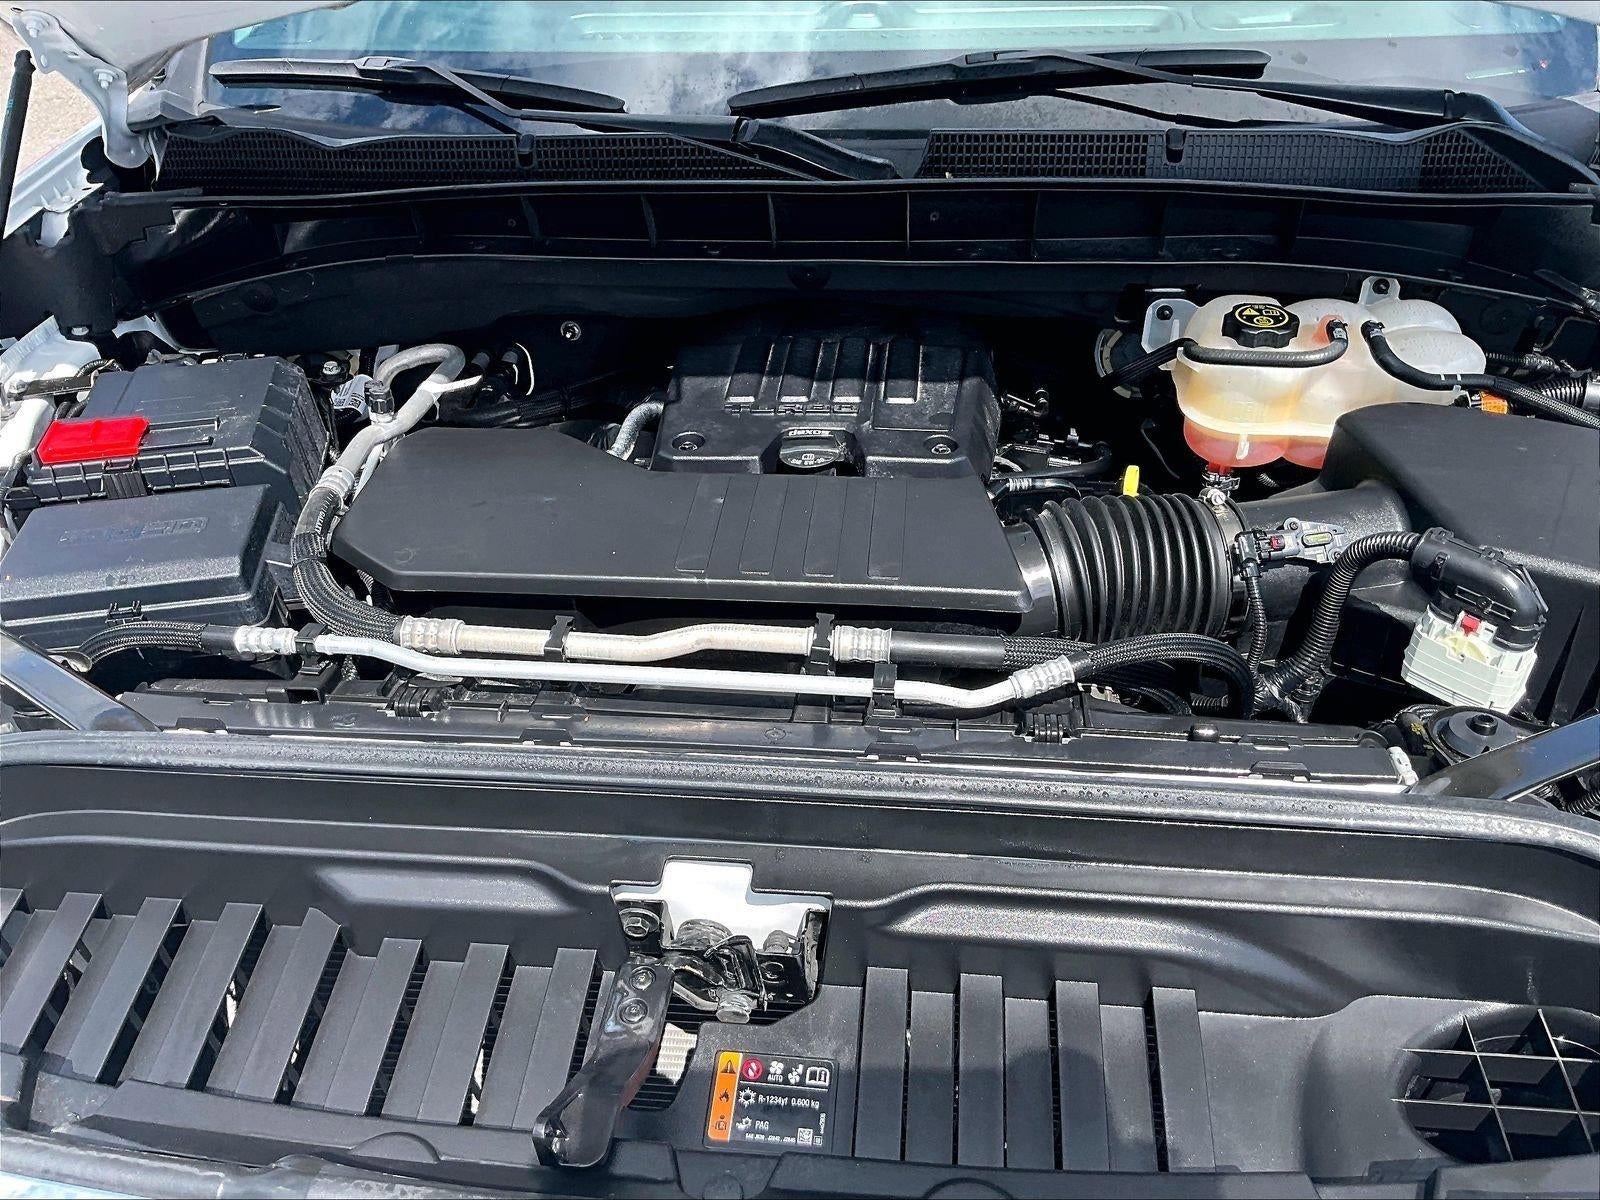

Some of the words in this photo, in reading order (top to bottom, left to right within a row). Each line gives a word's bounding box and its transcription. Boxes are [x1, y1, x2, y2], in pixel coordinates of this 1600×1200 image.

[768, 1073, 783, 1082] AUTO
[758, 1094, 788, 1106] R-1234yf
[791, 1097, 810, 1108] 0.600
[811, 1099, 820, 1110] kg
[755, 1120, 770, 1131] PAG
